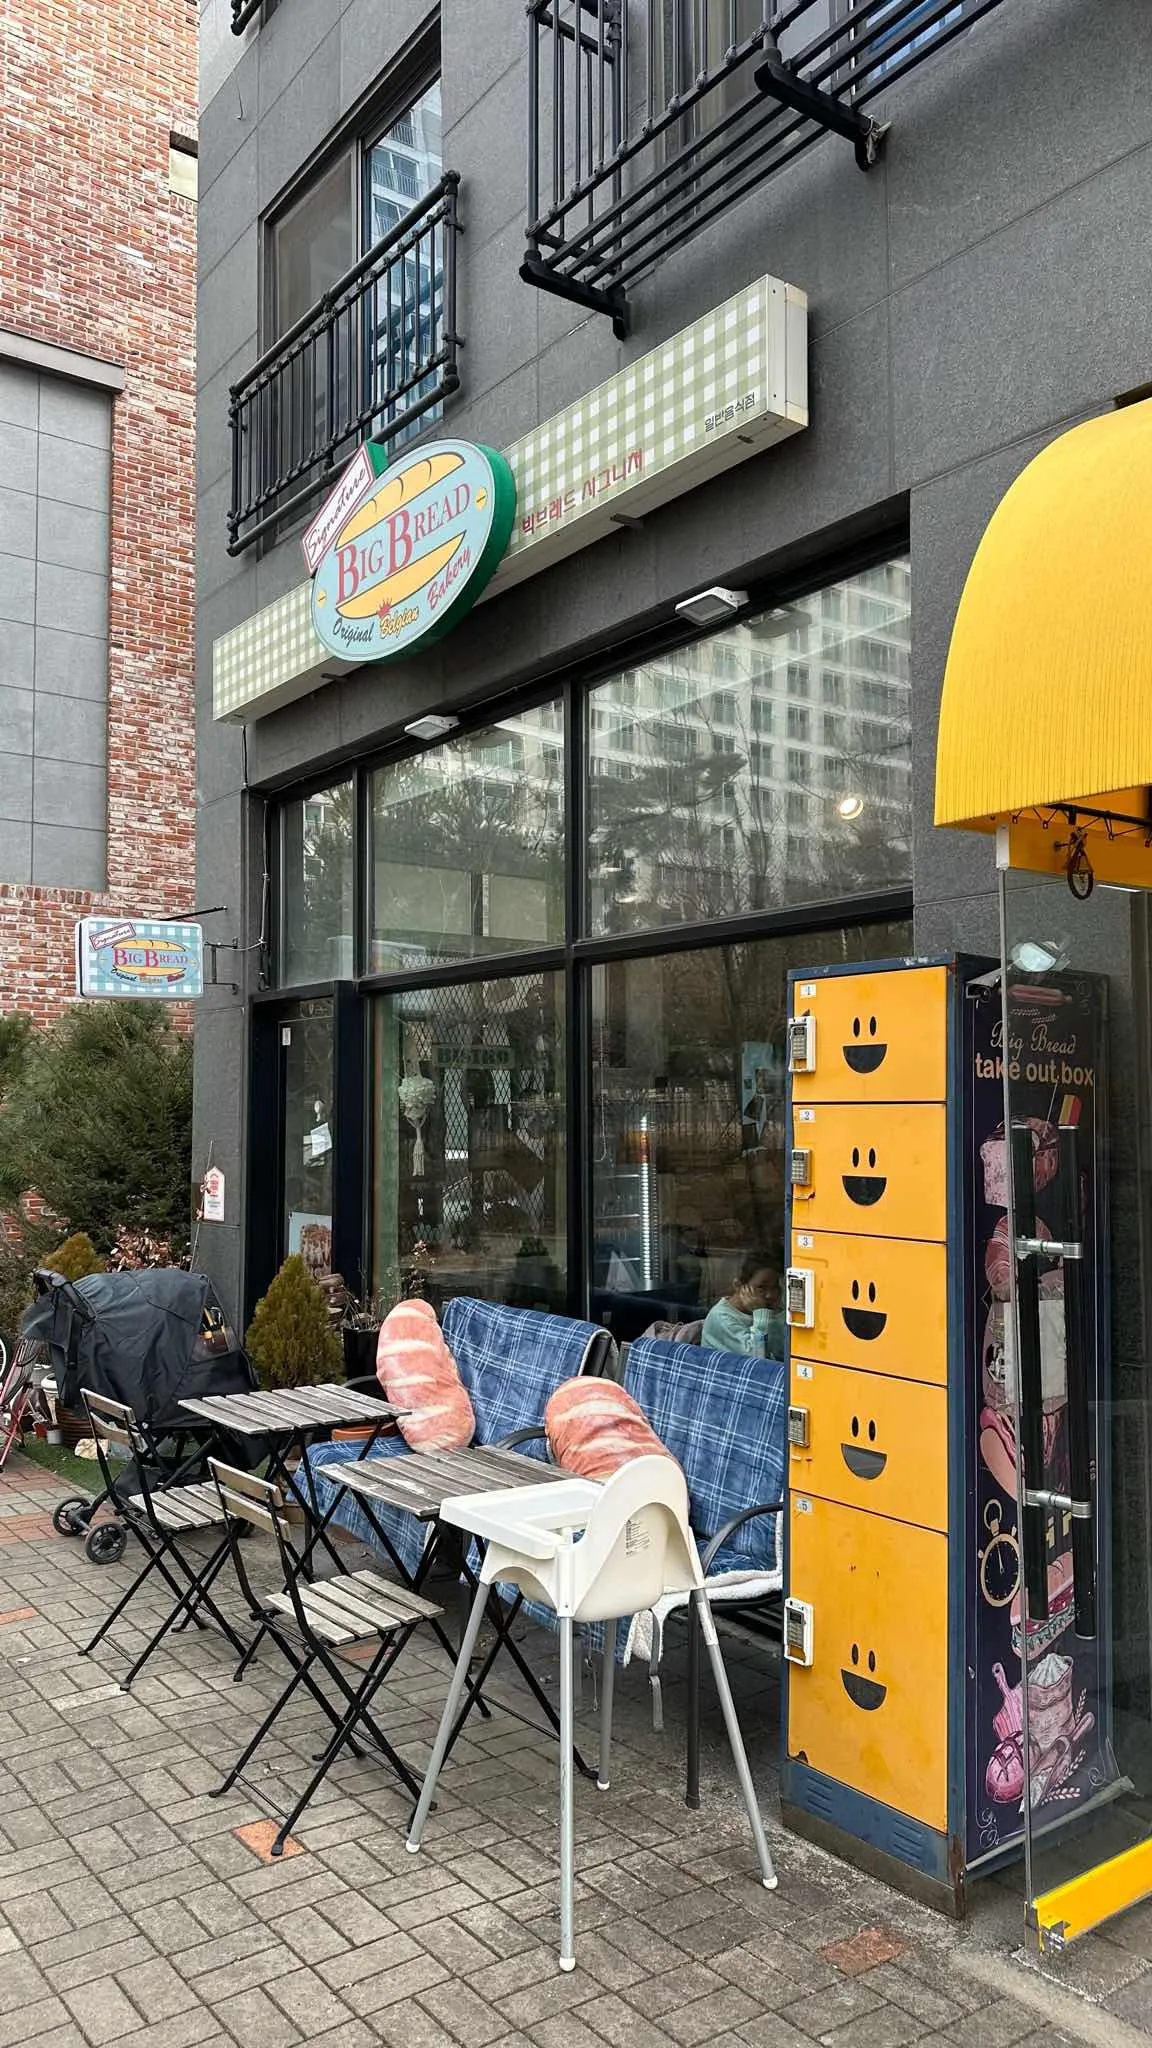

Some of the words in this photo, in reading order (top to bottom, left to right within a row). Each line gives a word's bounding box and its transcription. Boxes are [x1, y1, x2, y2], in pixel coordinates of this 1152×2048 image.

[704, 392, 756, 433] 일반음식점
[307, 467, 366, 558] Signature
[522, 488, 576, 534] 빅브레드
[336, 540, 384, 604] BIG
[385, 483, 470, 577] BREAD
[333, 617, 373, 648] Original
[379, 605, 420, 639] Belgian
[428, 546, 472, 610] Bakery
[113, 948, 142, 966] BIG
[144, 948, 188, 968] BREAD
[990, 1020, 1024, 1060] Big
[1031, 1024, 1076, 1055] Bread
[1026, 1060, 1058, 1082] out
[1061, 1060, 1094, 1086] box
